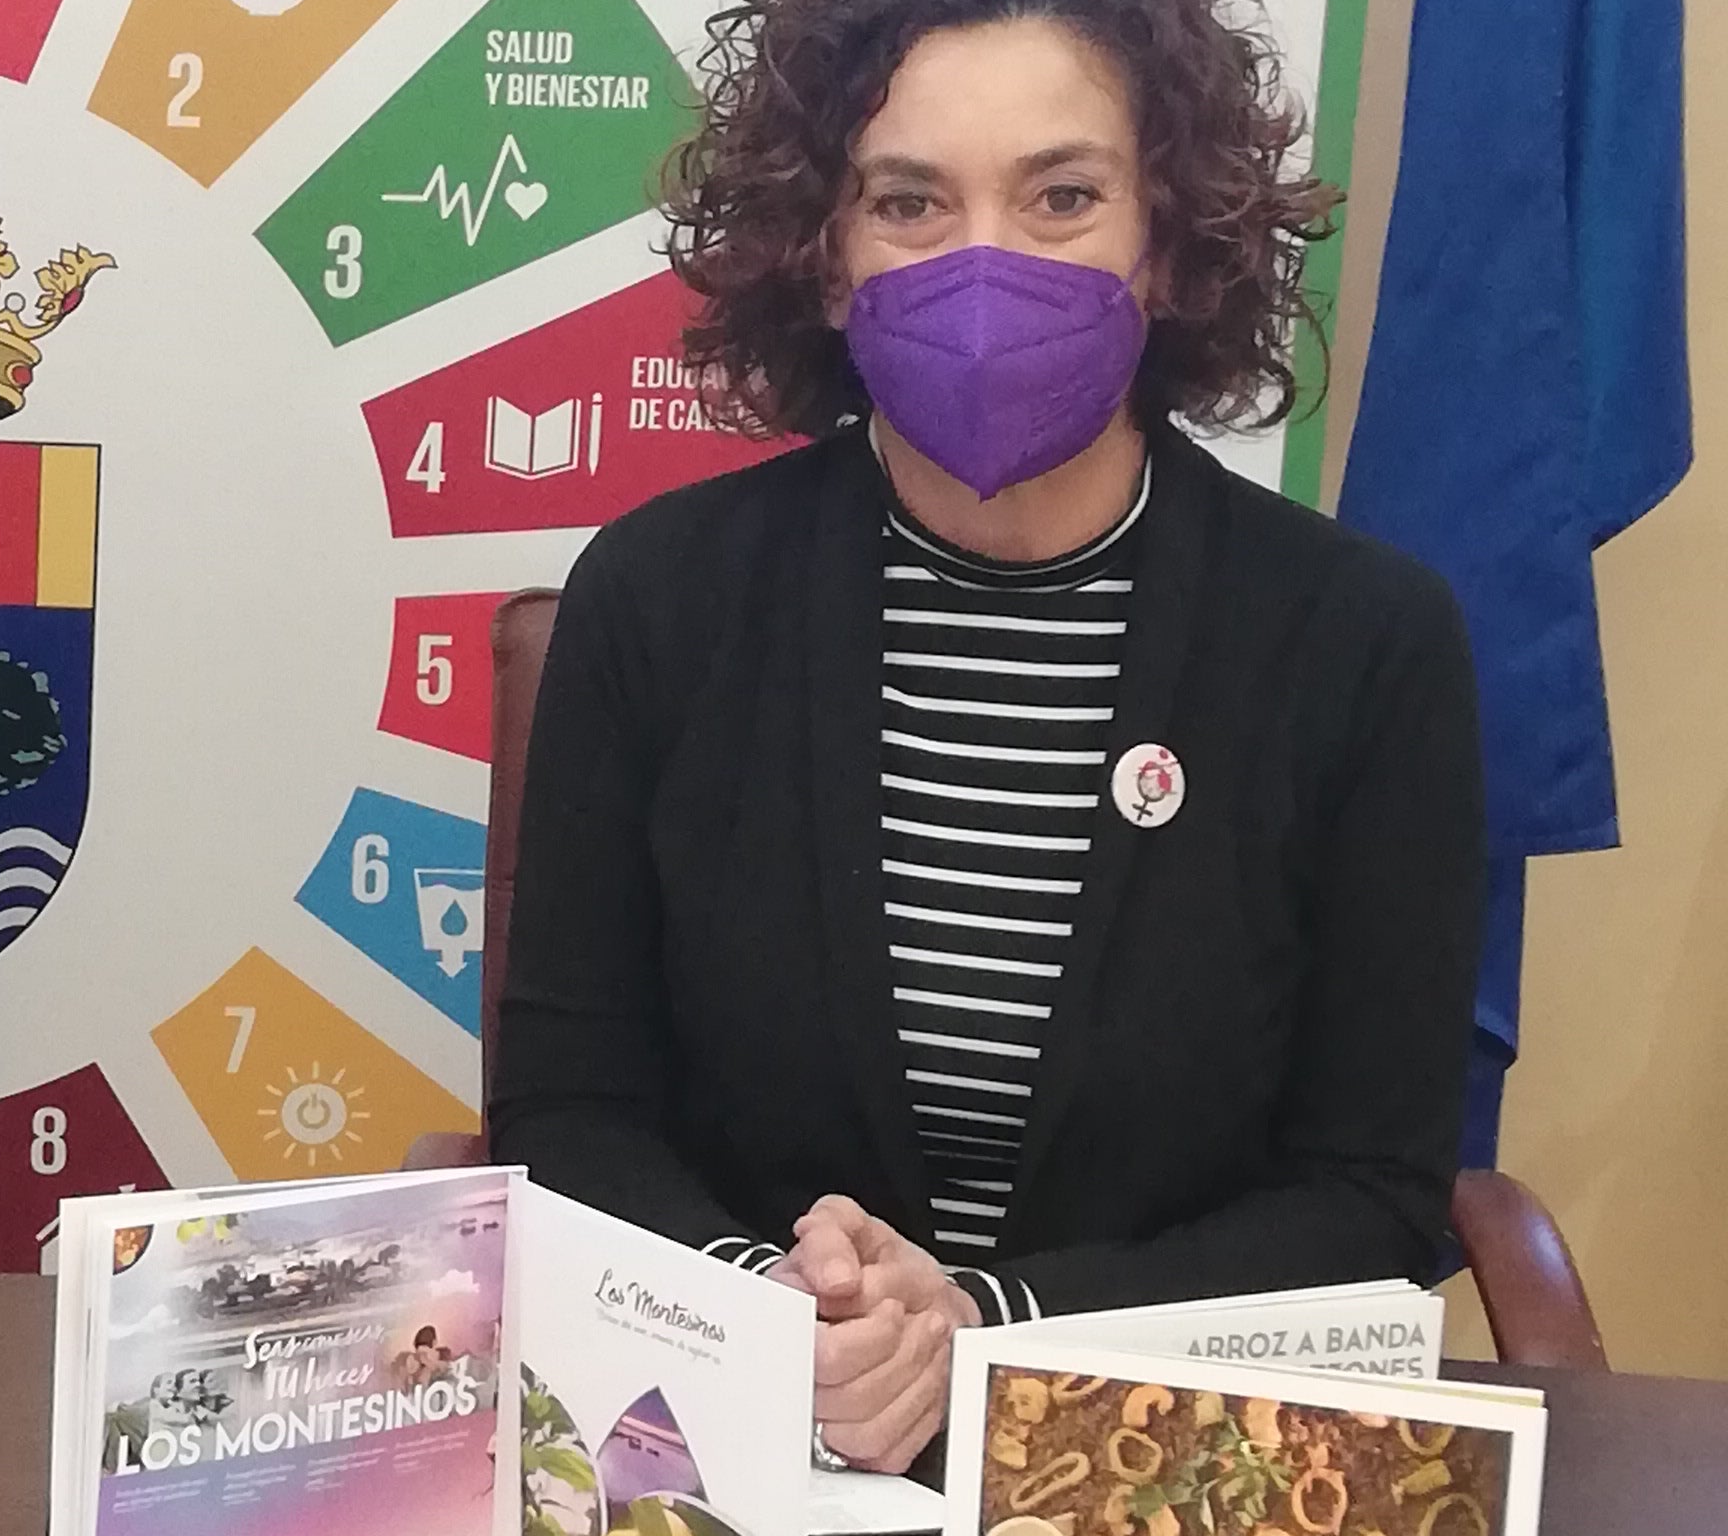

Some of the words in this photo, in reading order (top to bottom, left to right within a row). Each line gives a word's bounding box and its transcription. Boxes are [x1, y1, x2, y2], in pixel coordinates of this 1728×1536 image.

[485, 30, 573, 64] SALUD
[166, 52, 204, 128] 2
[485, 74, 499, 105] Y
[507, 75, 650, 109] BIENESTAR
[324, 225, 362, 299] 3
[629, 398, 663, 430] DE
[405, 422, 446, 494] 4
[416, 633, 452, 705] 5
[351, 833, 389, 904] 6
[223, 1006, 256, 1073] 7
[30, 1106, 68, 1175] 8
[595, 1268, 625, 1307] Los
[627, 1281, 725, 1343] Montesinos
[1187, 1330, 1287, 1360] ARROZ
[1296, 1331, 1316, 1355] A
[1326, 1321, 1426, 1354] BANDA
[115, 1424, 201, 1476] LOS
[215, 1378, 477, 1461] MONTESINOS
